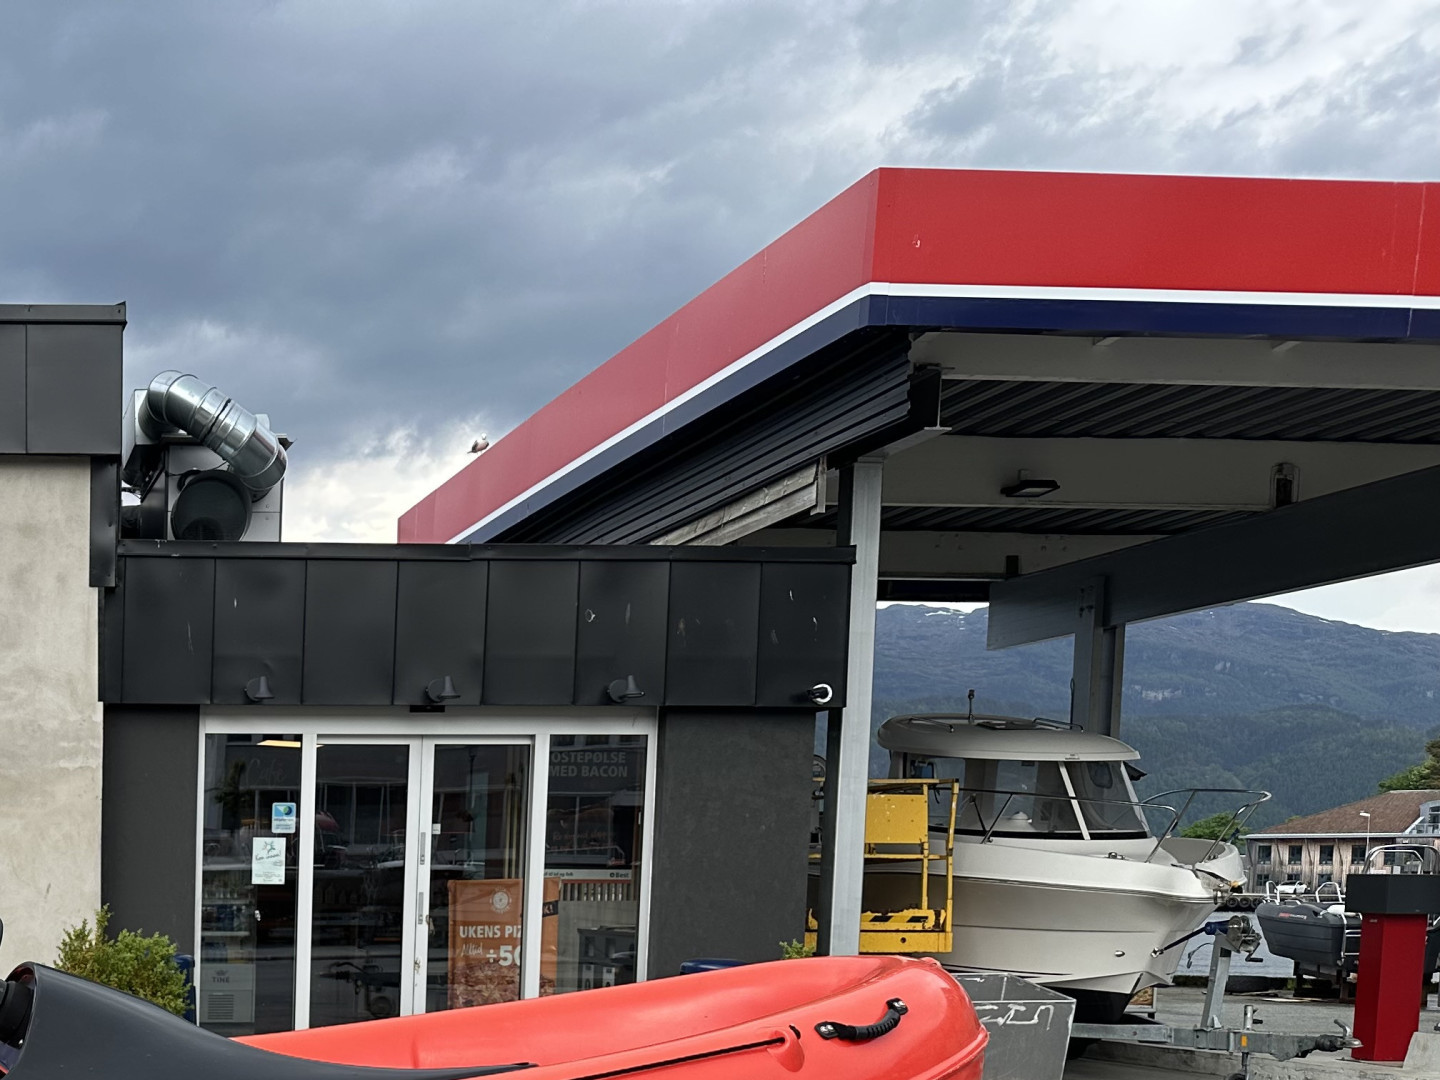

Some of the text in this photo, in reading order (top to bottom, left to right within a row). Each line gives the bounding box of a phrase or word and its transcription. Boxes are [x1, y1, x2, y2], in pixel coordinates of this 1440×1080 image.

[581, 765, 628, 778] BACON
[460, 925, 522, 938] UKENS PIZ
